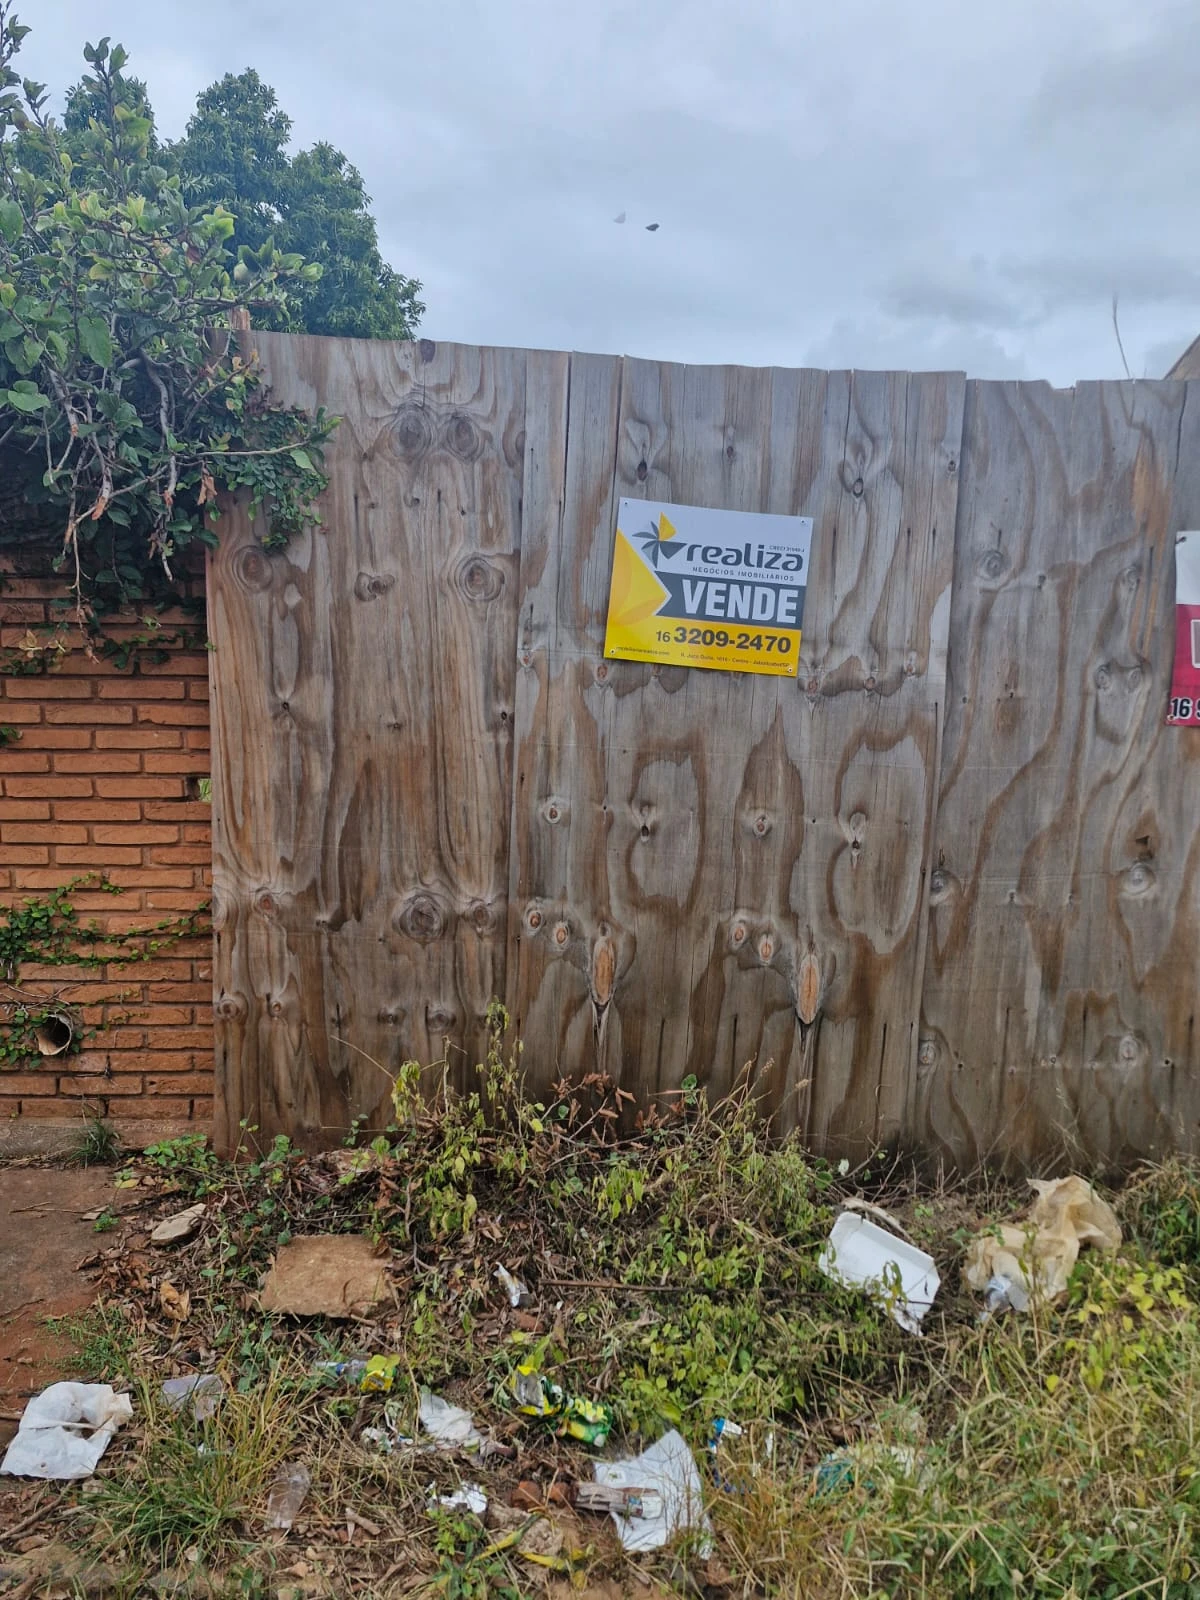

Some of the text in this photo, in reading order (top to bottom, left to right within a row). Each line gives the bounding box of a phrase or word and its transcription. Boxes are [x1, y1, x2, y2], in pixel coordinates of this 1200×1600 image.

[686, 543, 804, 572] realiza
[682, 579, 799, 624] VENDE
[656, 630, 671, 643] 16
[674, 626, 791, 654] 3209-2470
[1171, 697, 1192, 718] 16
